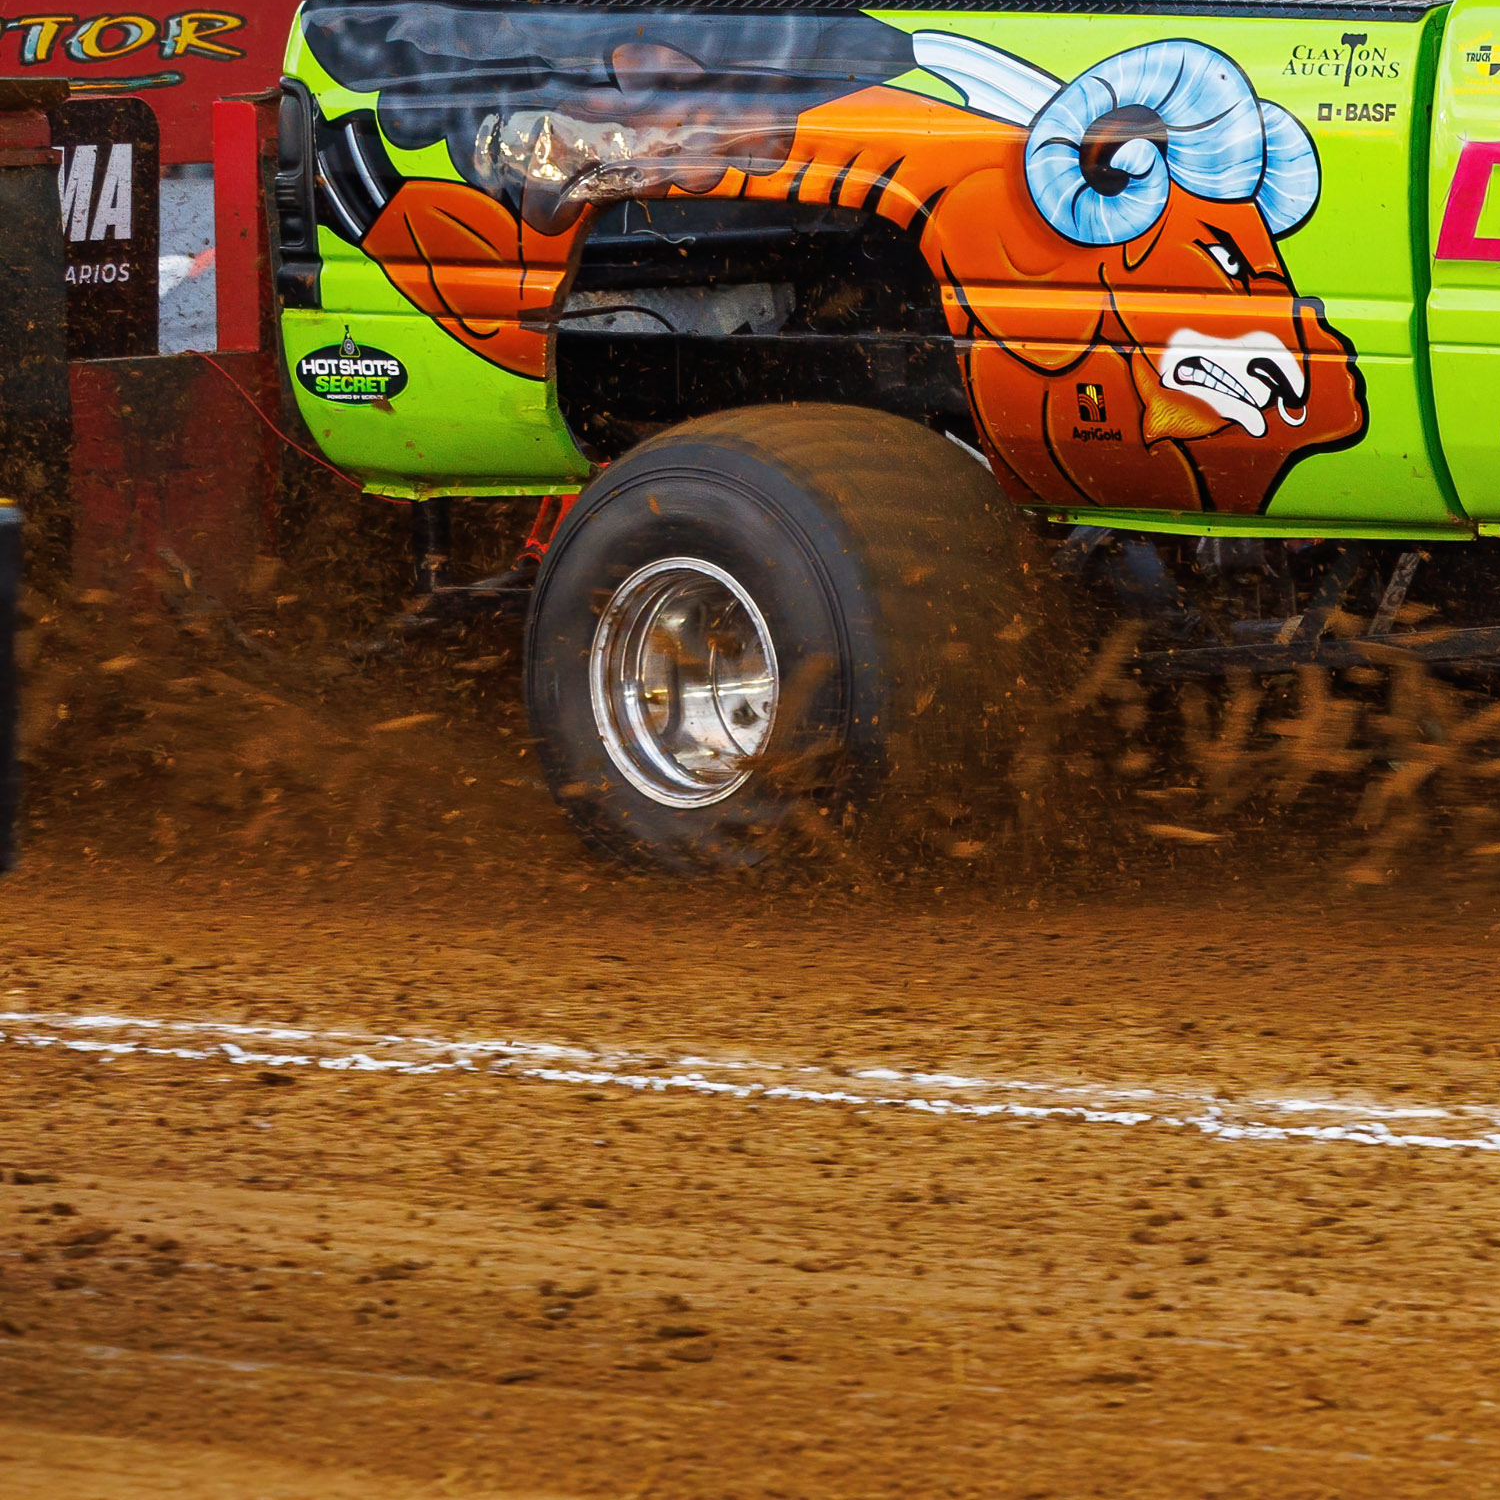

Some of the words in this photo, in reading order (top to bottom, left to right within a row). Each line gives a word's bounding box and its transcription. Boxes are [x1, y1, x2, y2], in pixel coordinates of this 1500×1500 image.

[0, 11, 248, 67] TOR
[1466, 52, 1491, 62] TRUCK
[1345, 103, 1397, 122] BASF
[315, 376, 389, 393] SECRET
[1073, 426, 1122, 443] AgriGold
